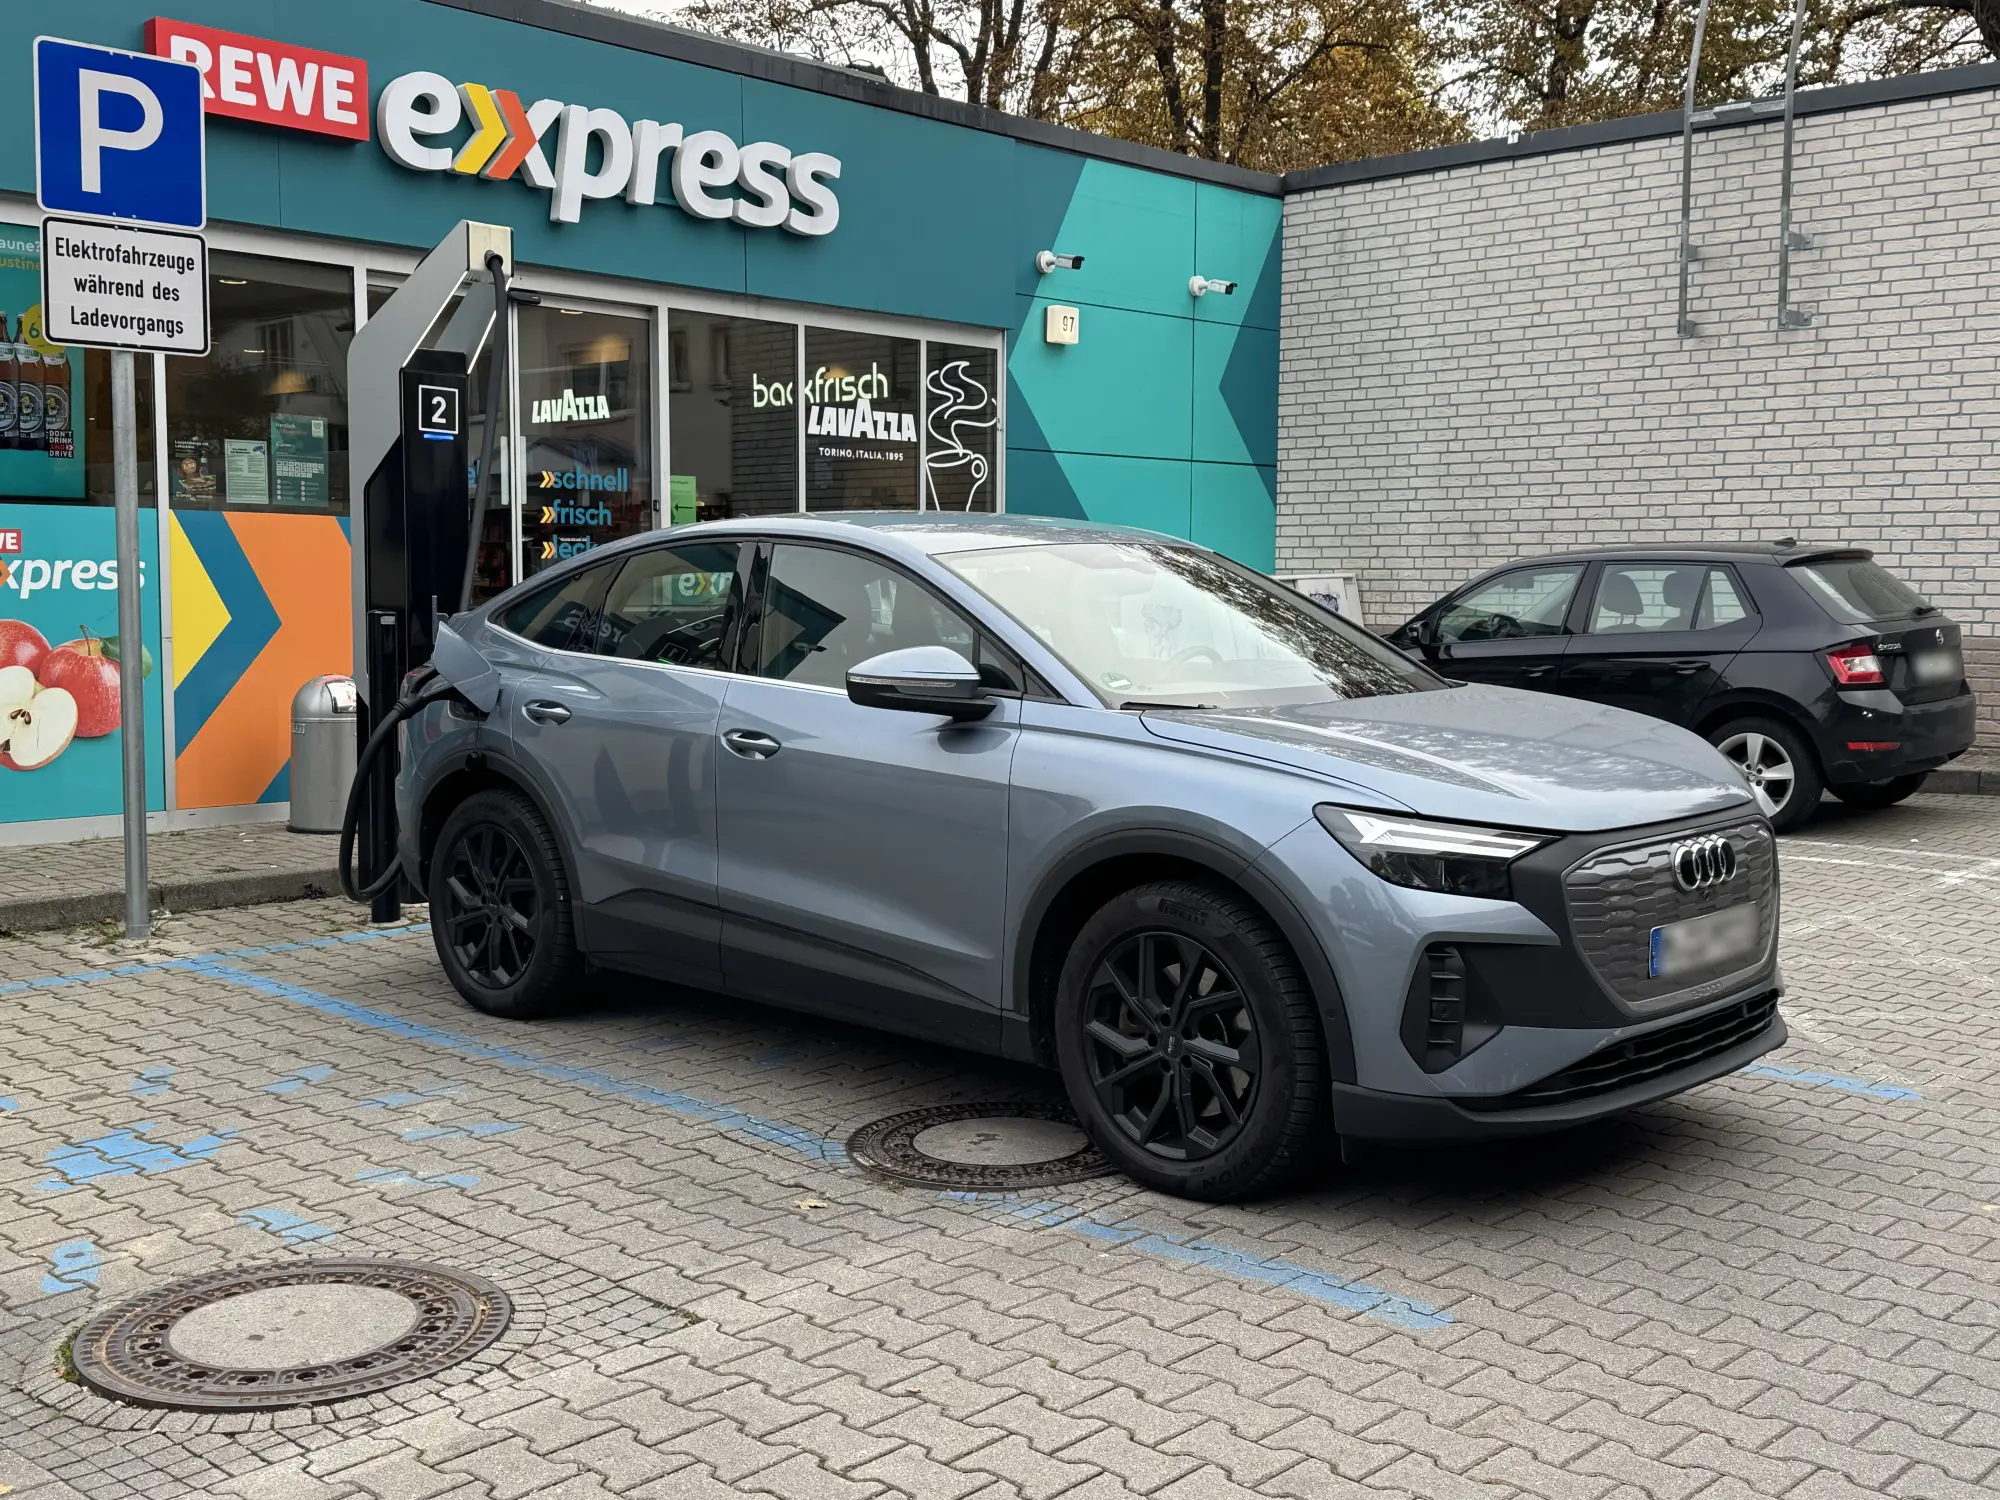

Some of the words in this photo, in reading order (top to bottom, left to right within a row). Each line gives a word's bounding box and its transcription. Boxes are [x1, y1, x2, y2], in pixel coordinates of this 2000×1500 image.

[170, 34, 358, 125] REWE
[79, 69, 163, 193] P
[377, 71, 841, 236] express
[56, 237, 194, 274] Elektrofahrzeuge
[74, 275, 144, 298] während
[152, 281, 180, 301] des
[71, 305, 184, 338] Ladevorgangs
[1062, 315, 1075, 333] 97
[431, 396, 447, 424] 2
[532, 389, 610, 423] LAVAZZA
[807, 398, 917, 442] LAVAZZA
[49, 430, 72, 438] DON'T
[49, 450, 72, 458] DRIVE
[553, 466, 628, 492] schnell
[552, 499, 612, 526] frisch
[5, 559, 146, 599] xpres
